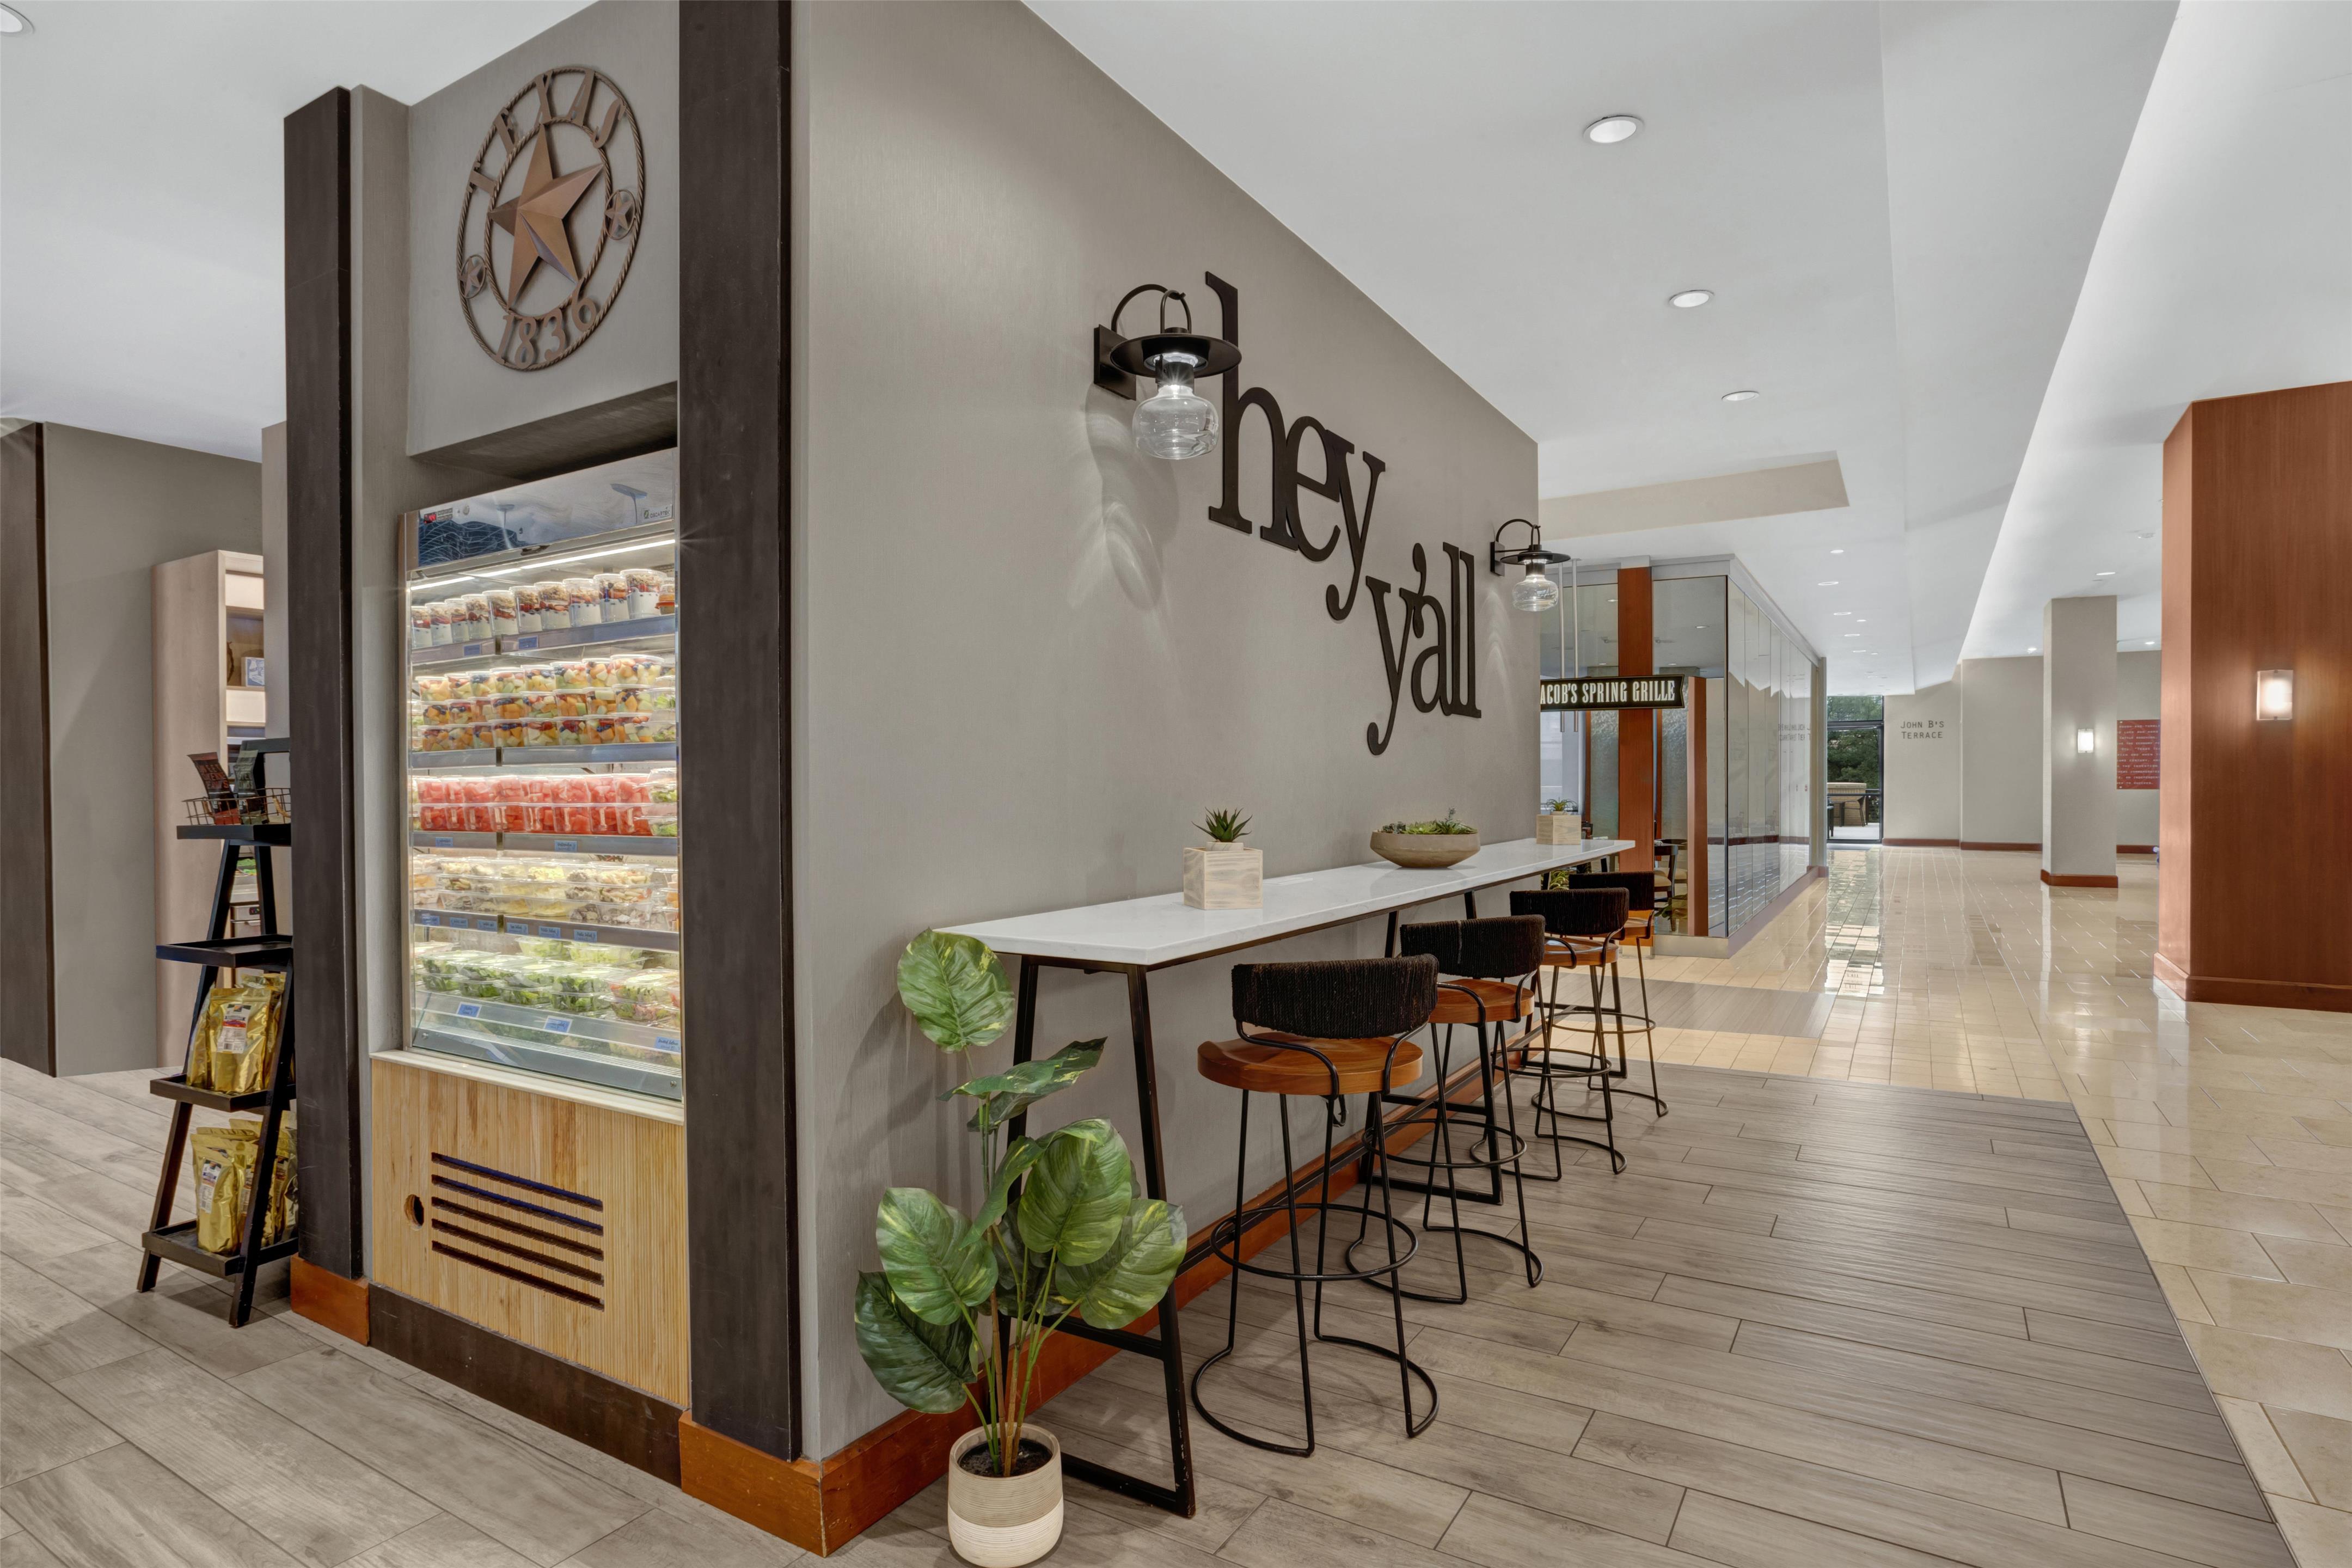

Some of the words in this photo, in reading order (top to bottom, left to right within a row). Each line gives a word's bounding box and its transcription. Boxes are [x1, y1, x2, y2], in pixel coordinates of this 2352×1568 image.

[467, 69, 628, 198] TEXAS
[494, 278, 598, 369] 1836
[1205, 271, 1386, 621] hey
[1365, 542, 1482, 756] y'all
[1540, 683, 1577, 704] ACOB'S
[1582, 682, 1627, 703] SPRING
[1633, 681, 1675, 702] GRILLE
